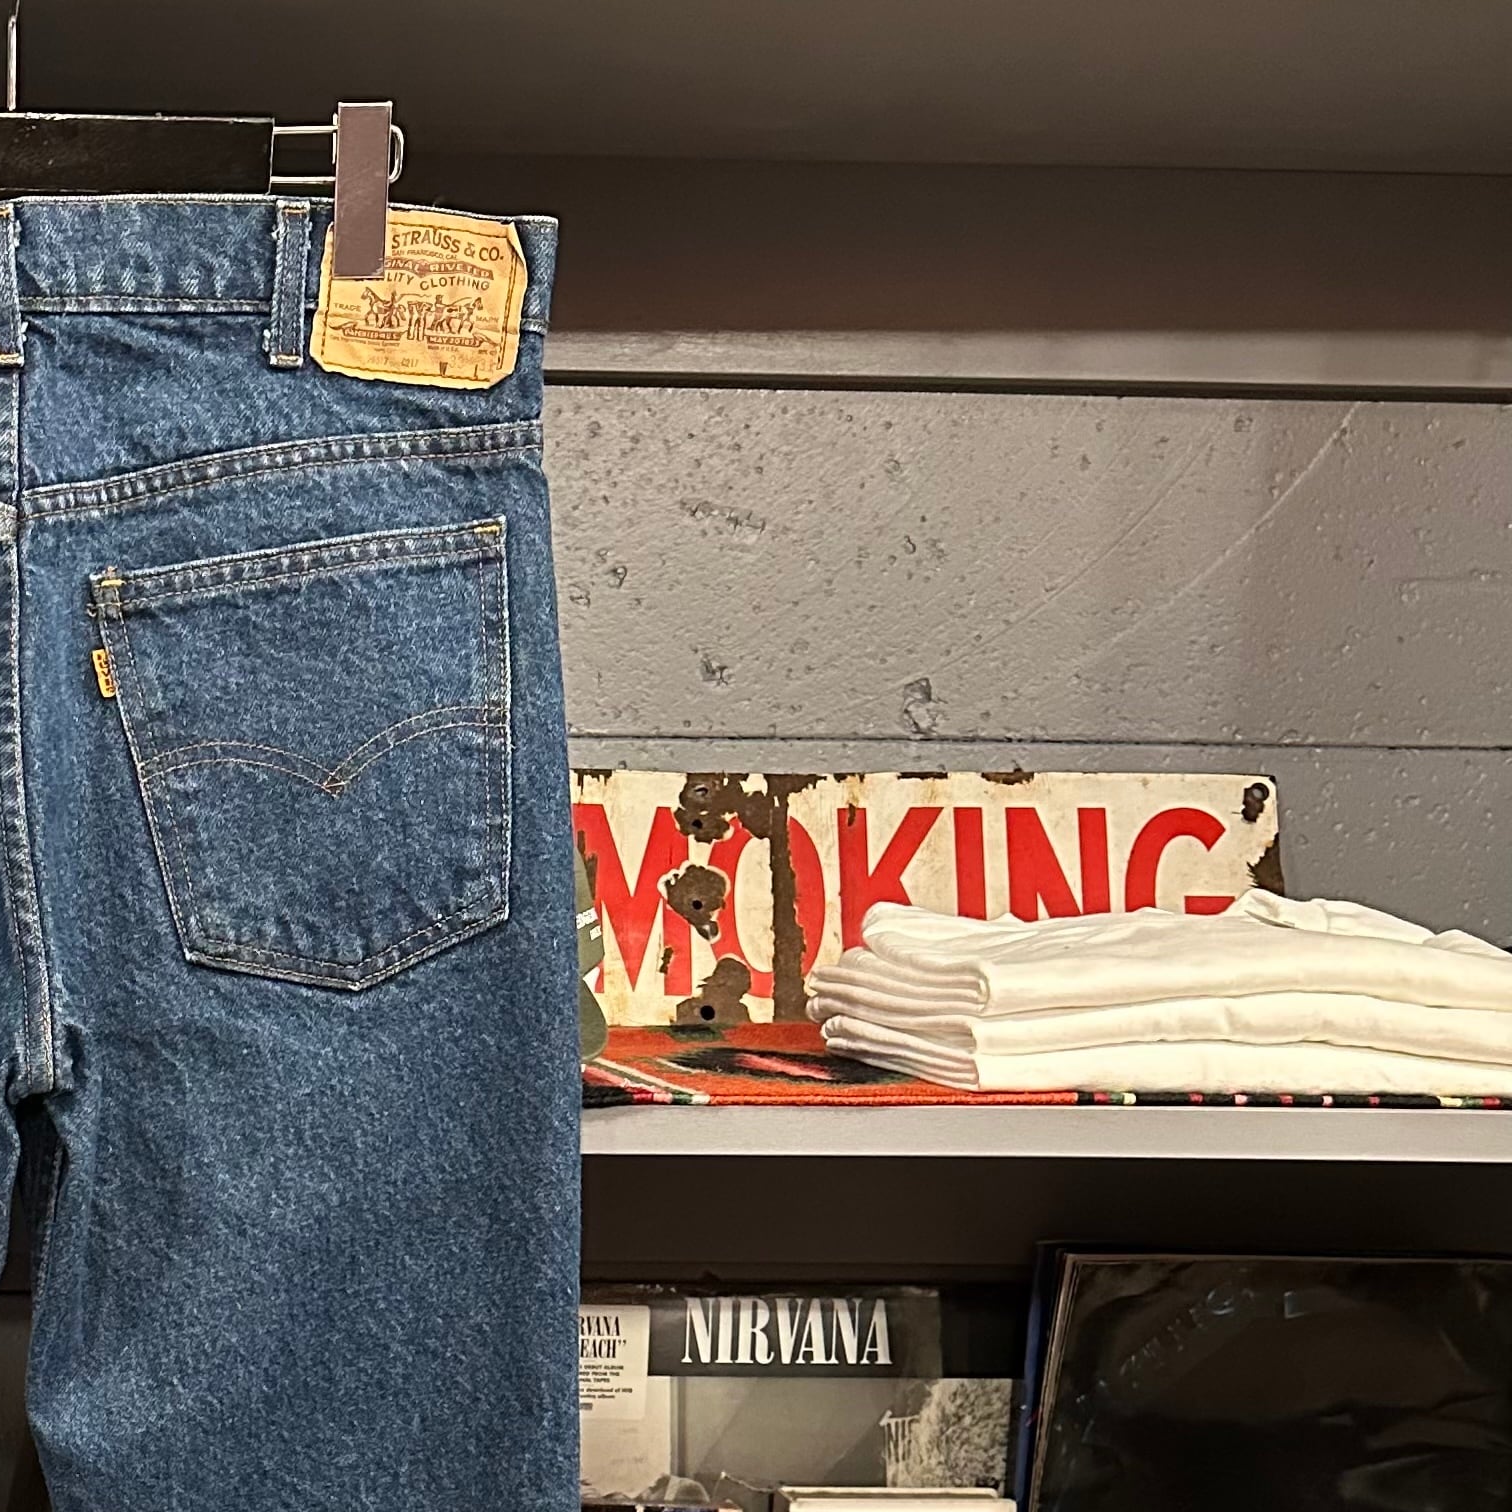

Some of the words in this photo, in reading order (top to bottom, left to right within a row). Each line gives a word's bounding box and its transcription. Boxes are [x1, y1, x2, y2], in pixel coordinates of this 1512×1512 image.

[391, 229, 460, 254] STRAUSS
[464, 242, 476, 258] &
[479, 247, 504, 262] CO.
[387, 271, 415, 286] LITY
[420, 275, 491, 291] CLOTHING
[681, 1297, 893, 1365] NIRVANA
